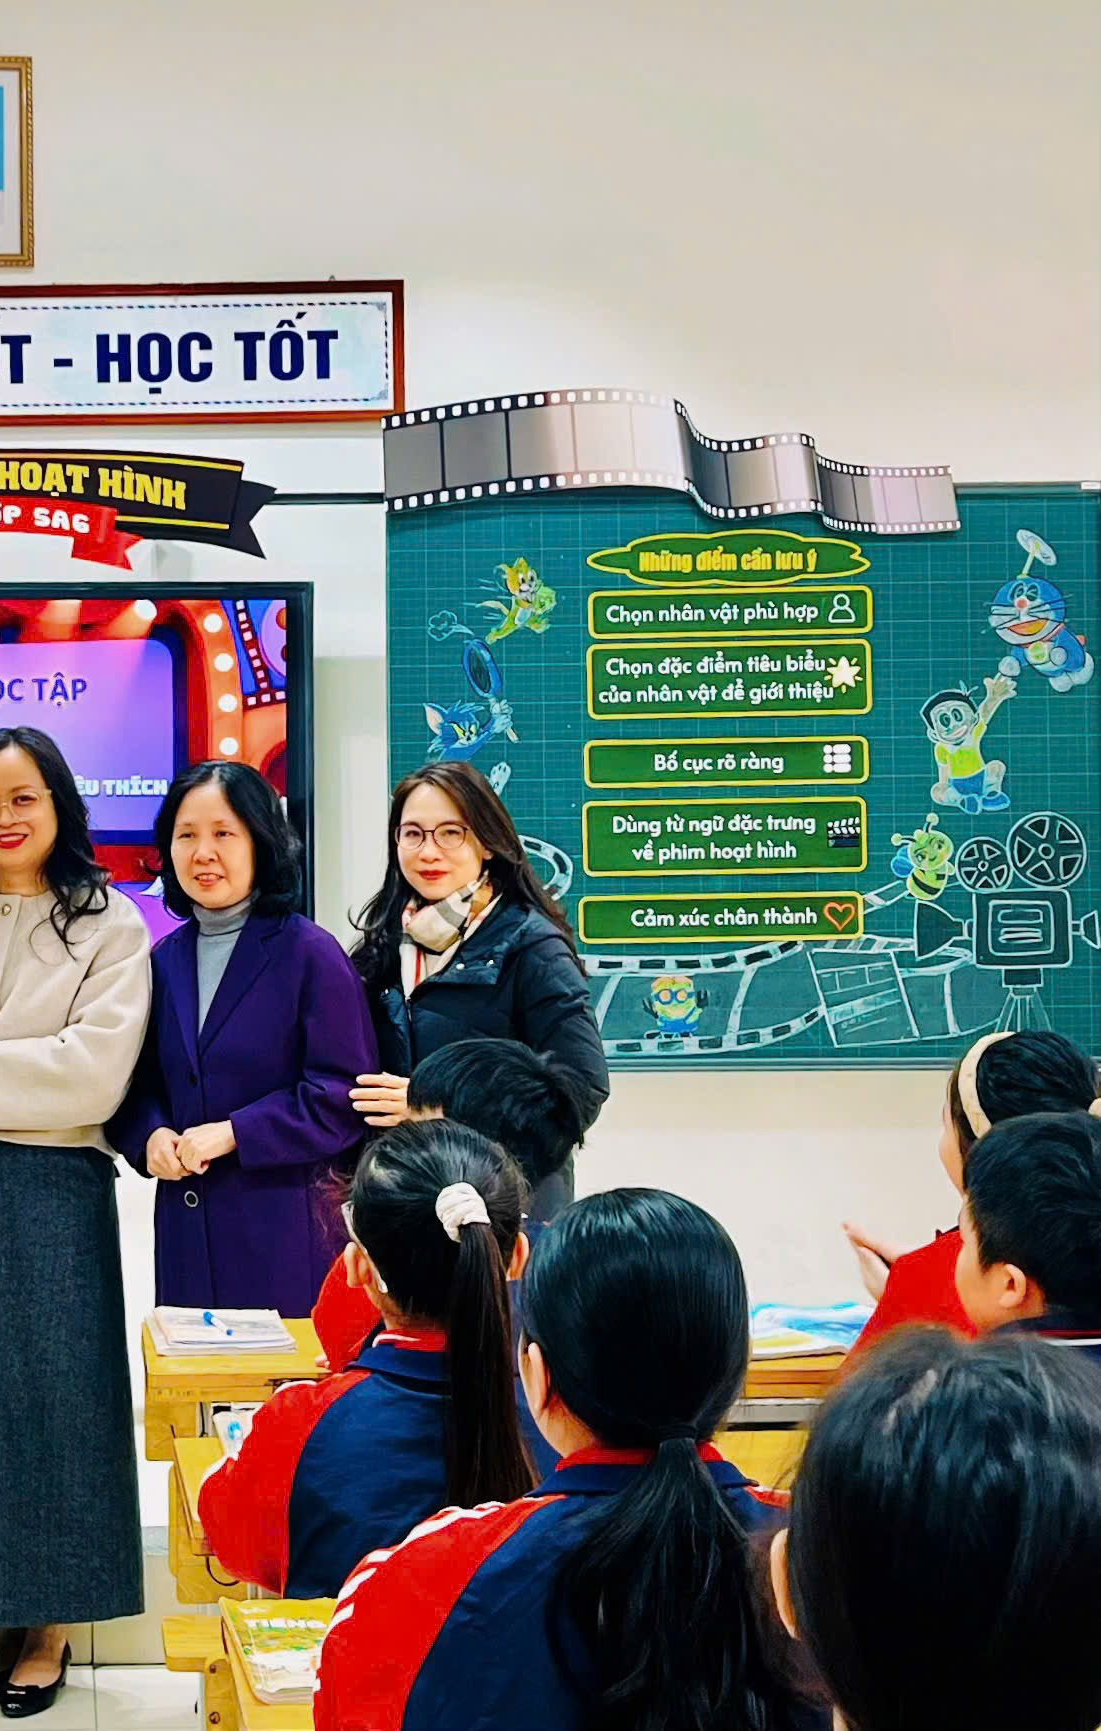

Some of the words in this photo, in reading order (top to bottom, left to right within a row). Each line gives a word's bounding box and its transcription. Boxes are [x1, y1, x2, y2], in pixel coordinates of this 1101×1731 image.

[53, 358, 73, 367] -
[96, 332, 213, 395] HỌC
[234, 311, 339, 381] TỐT
[98, 465, 187, 511] HÌNH
[638, 550, 693, 573] Những
[696, 545, 737, 571] điểm
[775, 550, 803, 570] lưu
[806, 548, 817, 573] ý
[605, 605, 653, 626] Chọn
[658, 603, 706, 622] nhân
[709, 603, 740, 624] vật
[743, 601, 779, 625] phù
[783, 602, 819, 623] hợp
[605, 657, 653, 679] Chọn
[657, 656, 692, 679] đặc
[696, 651, 743, 674] điểm
[747, 655, 781, 673] tiêu
[786, 649, 826, 671] biểu
[32, 672, 87, 707] TẬP
[598, 684, 631, 704] của
[636, 684, 683, 703] nhân
[687, 683, 718, 705] vật
[721, 678, 745, 701] để
[749, 681, 784, 705] giới
[788, 682, 834, 704] thiệu
[654, 751, 678, 772] Bố
[682, 757, 713, 775] cục
[717, 752, 737, 770] rõ
[740, 753, 785, 773] ràng
[102, 775, 168, 796] THÍCH
[612, 814, 662, 837] Dùng
[665, 813, 686, 833] từ
[688, 815, 724, 837] ngữ
[728, 813, 763, 834] đặc
[767, 815, 817, 834] trưng
[632, 839, 655, 861] về
[658, 842, 706, 864] phim
[709, 843, 753, 863] hoạt
[756, 841, 797, 859] hình
[630, 906, 675, 928] Cảm
[678, 907, 710, 927] xúc
[713, 906, 759, 926] chân
[762, 904, 818, 925] thành
